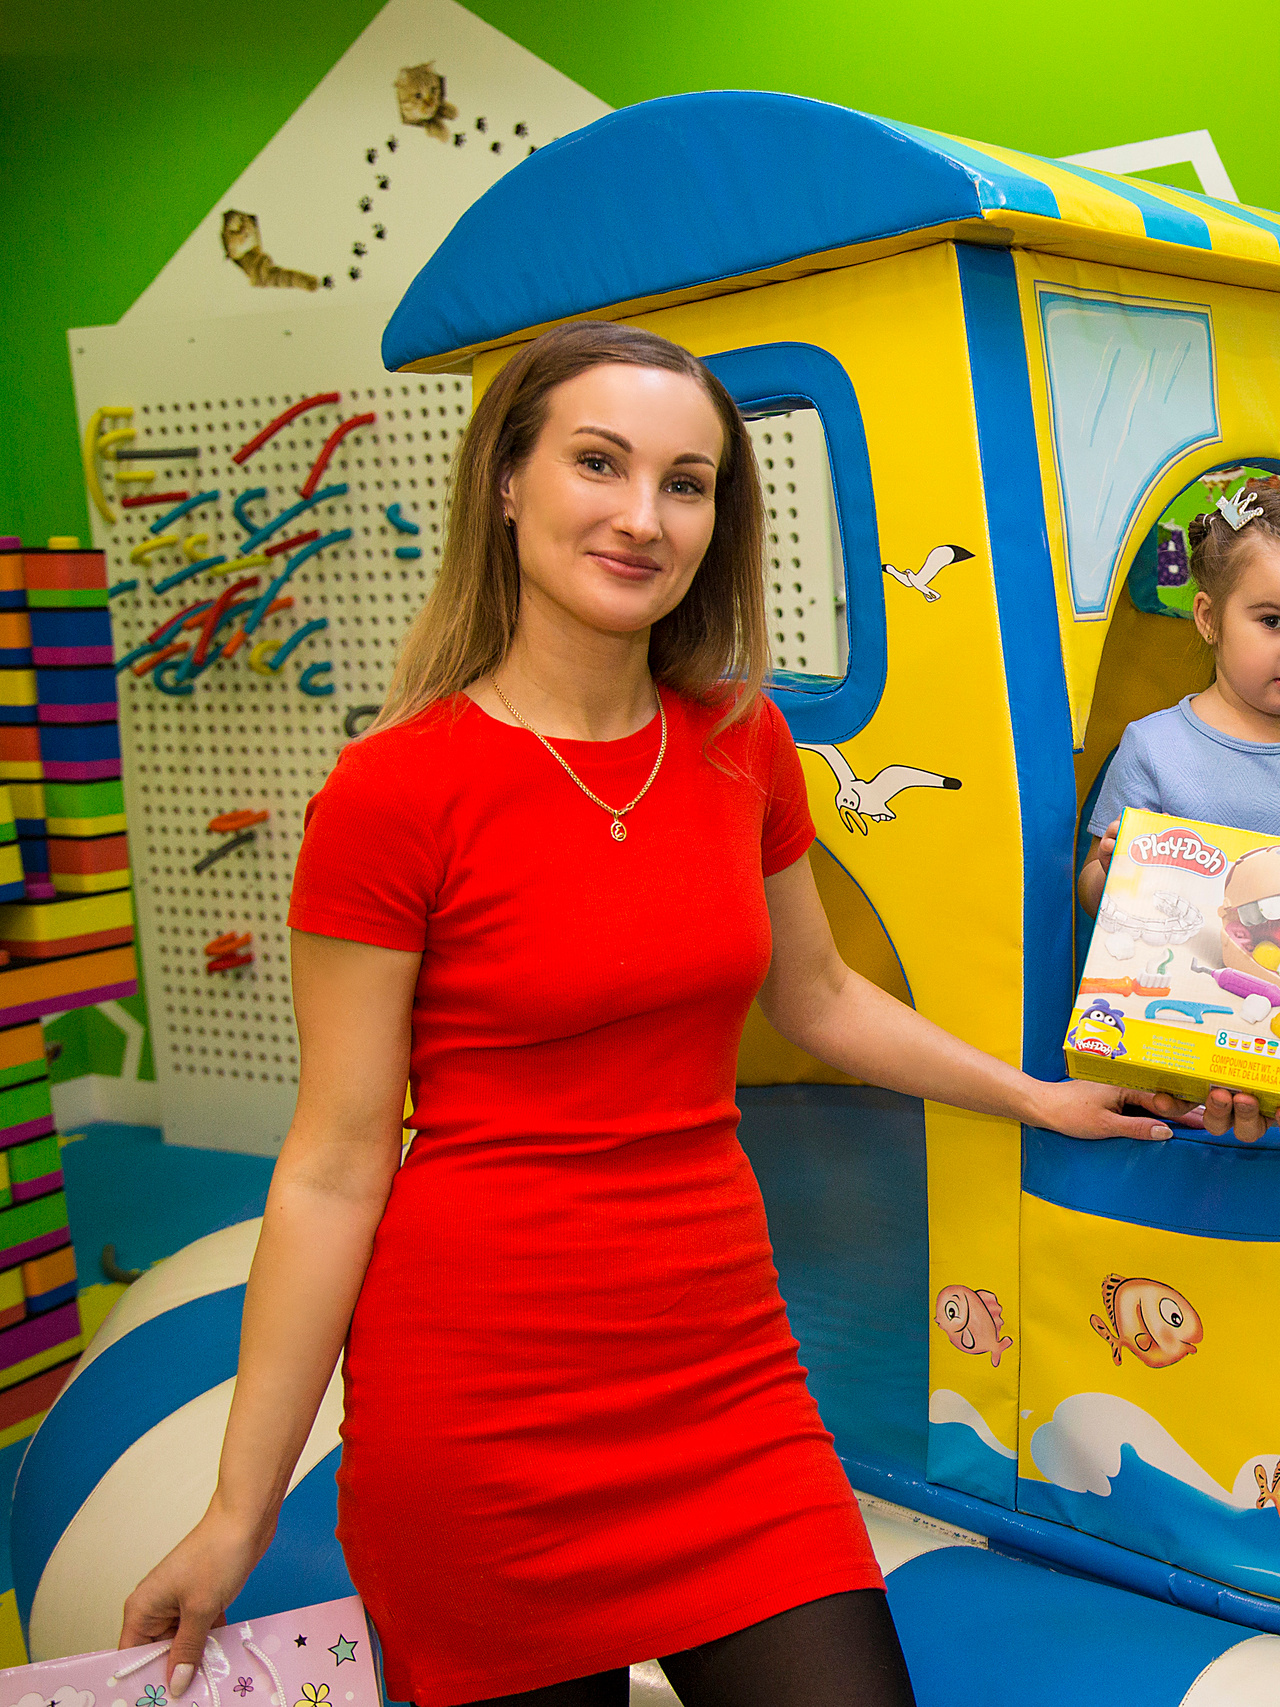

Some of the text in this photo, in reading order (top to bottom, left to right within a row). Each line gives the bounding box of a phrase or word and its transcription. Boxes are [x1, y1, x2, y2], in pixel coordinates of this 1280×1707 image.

[1133, 833, 1222, 873] Play-Doh
[1218, 1031, 1227, 1045] 8
[1076, 1039, 1112, 1056] Play-Doh
[1211, 1054, 1248, 1069] COMPOUND
[1248, 1061, 1261, 1072] NET
[1209, 1063, 1228, 1075] CONT.
[1242, 1069, 1251, 1080] DE
[1251, 1071, 1259, 1081] LA
[1260, 1073, 1278, 1085] MASA
